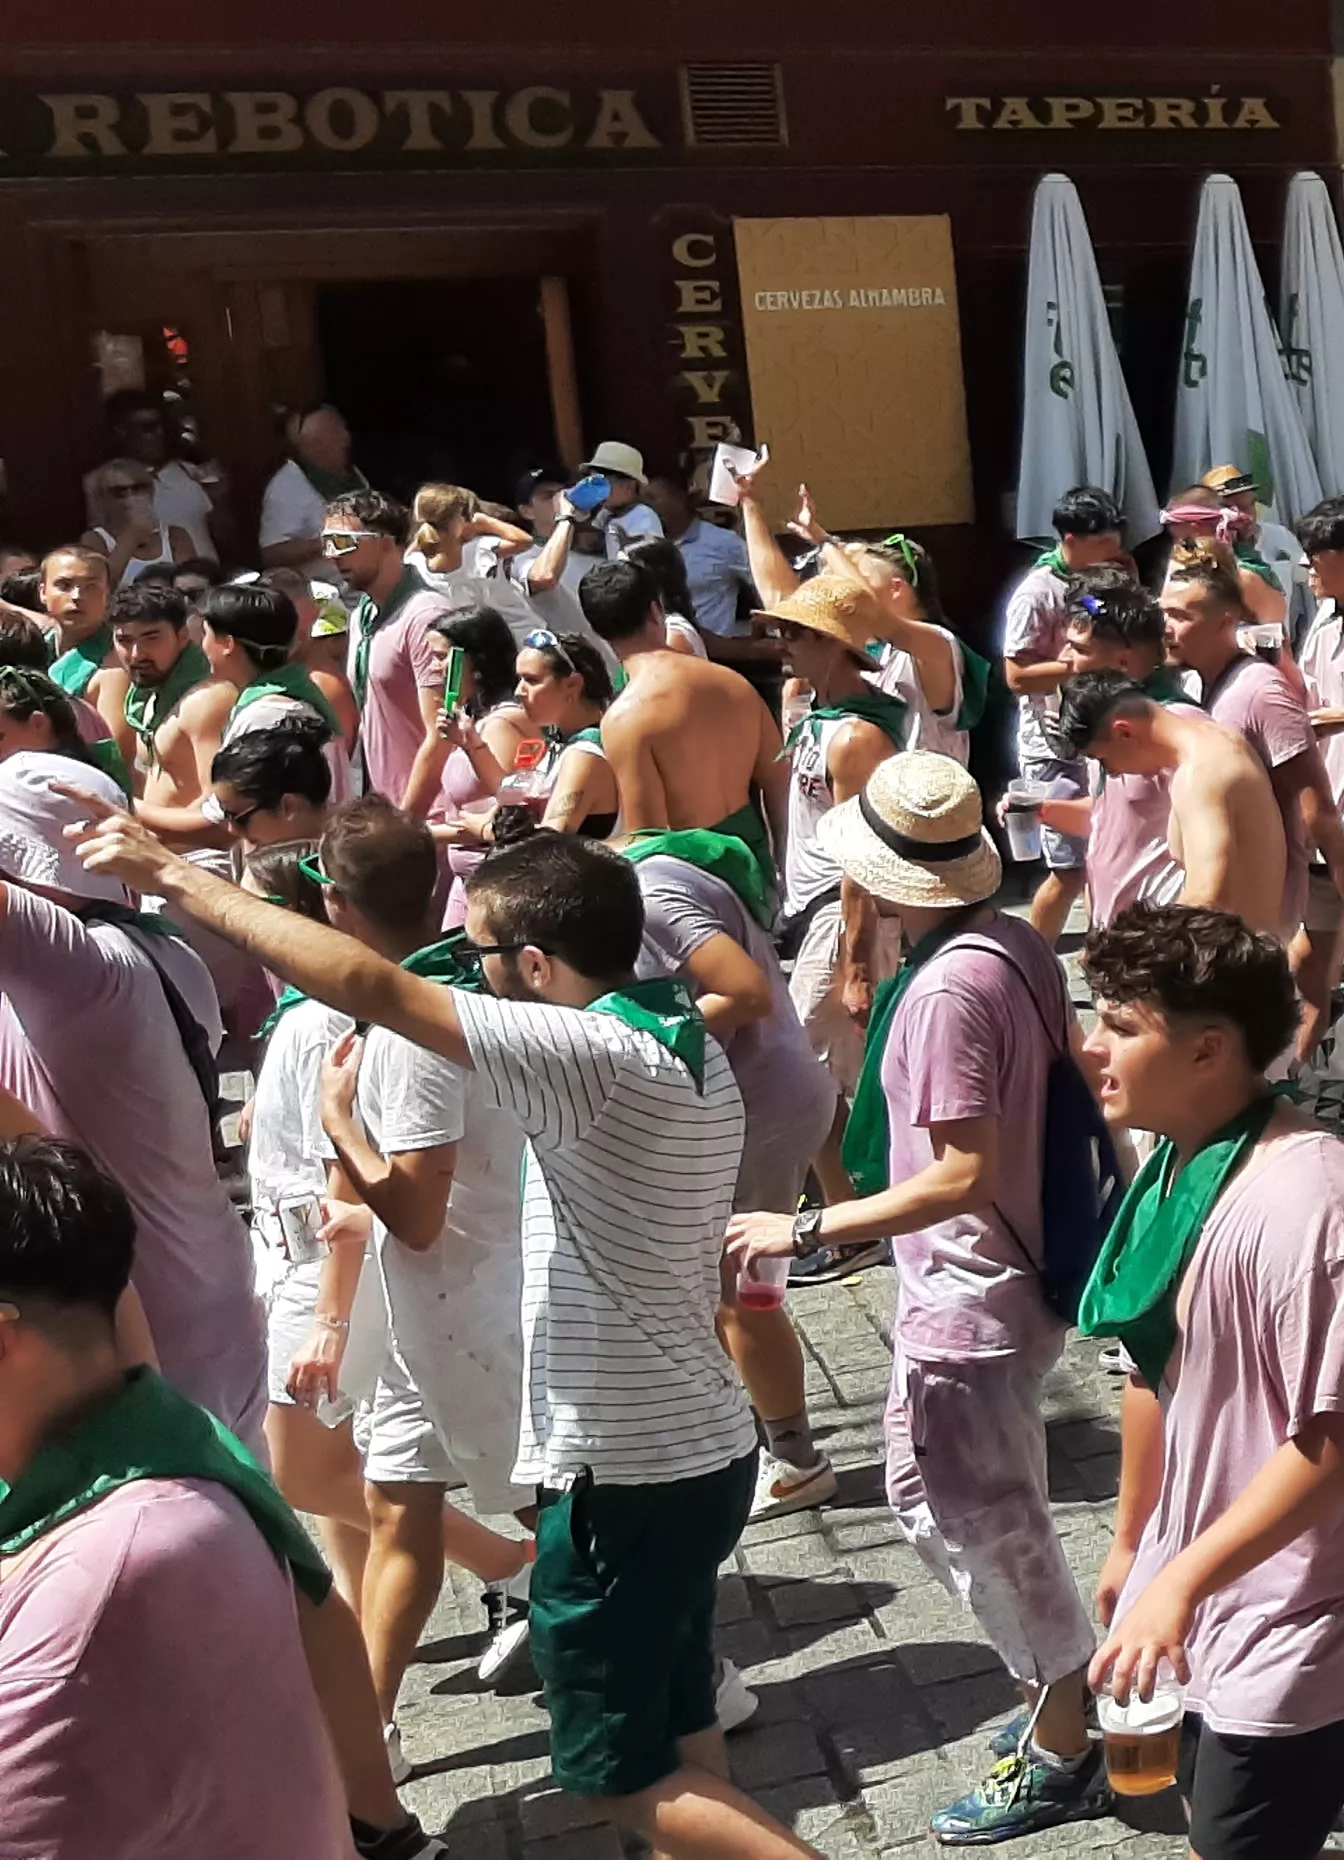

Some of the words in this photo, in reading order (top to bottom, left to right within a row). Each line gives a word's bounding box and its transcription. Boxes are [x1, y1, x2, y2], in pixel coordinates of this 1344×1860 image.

[37, 86, 660, 156] REBOTICA
[945, 83, 1281, 129] TAPERÍA
[755, 290, 843, 311] CERVEZAS
[850, 287, 947, 308] ALHAMBRA
